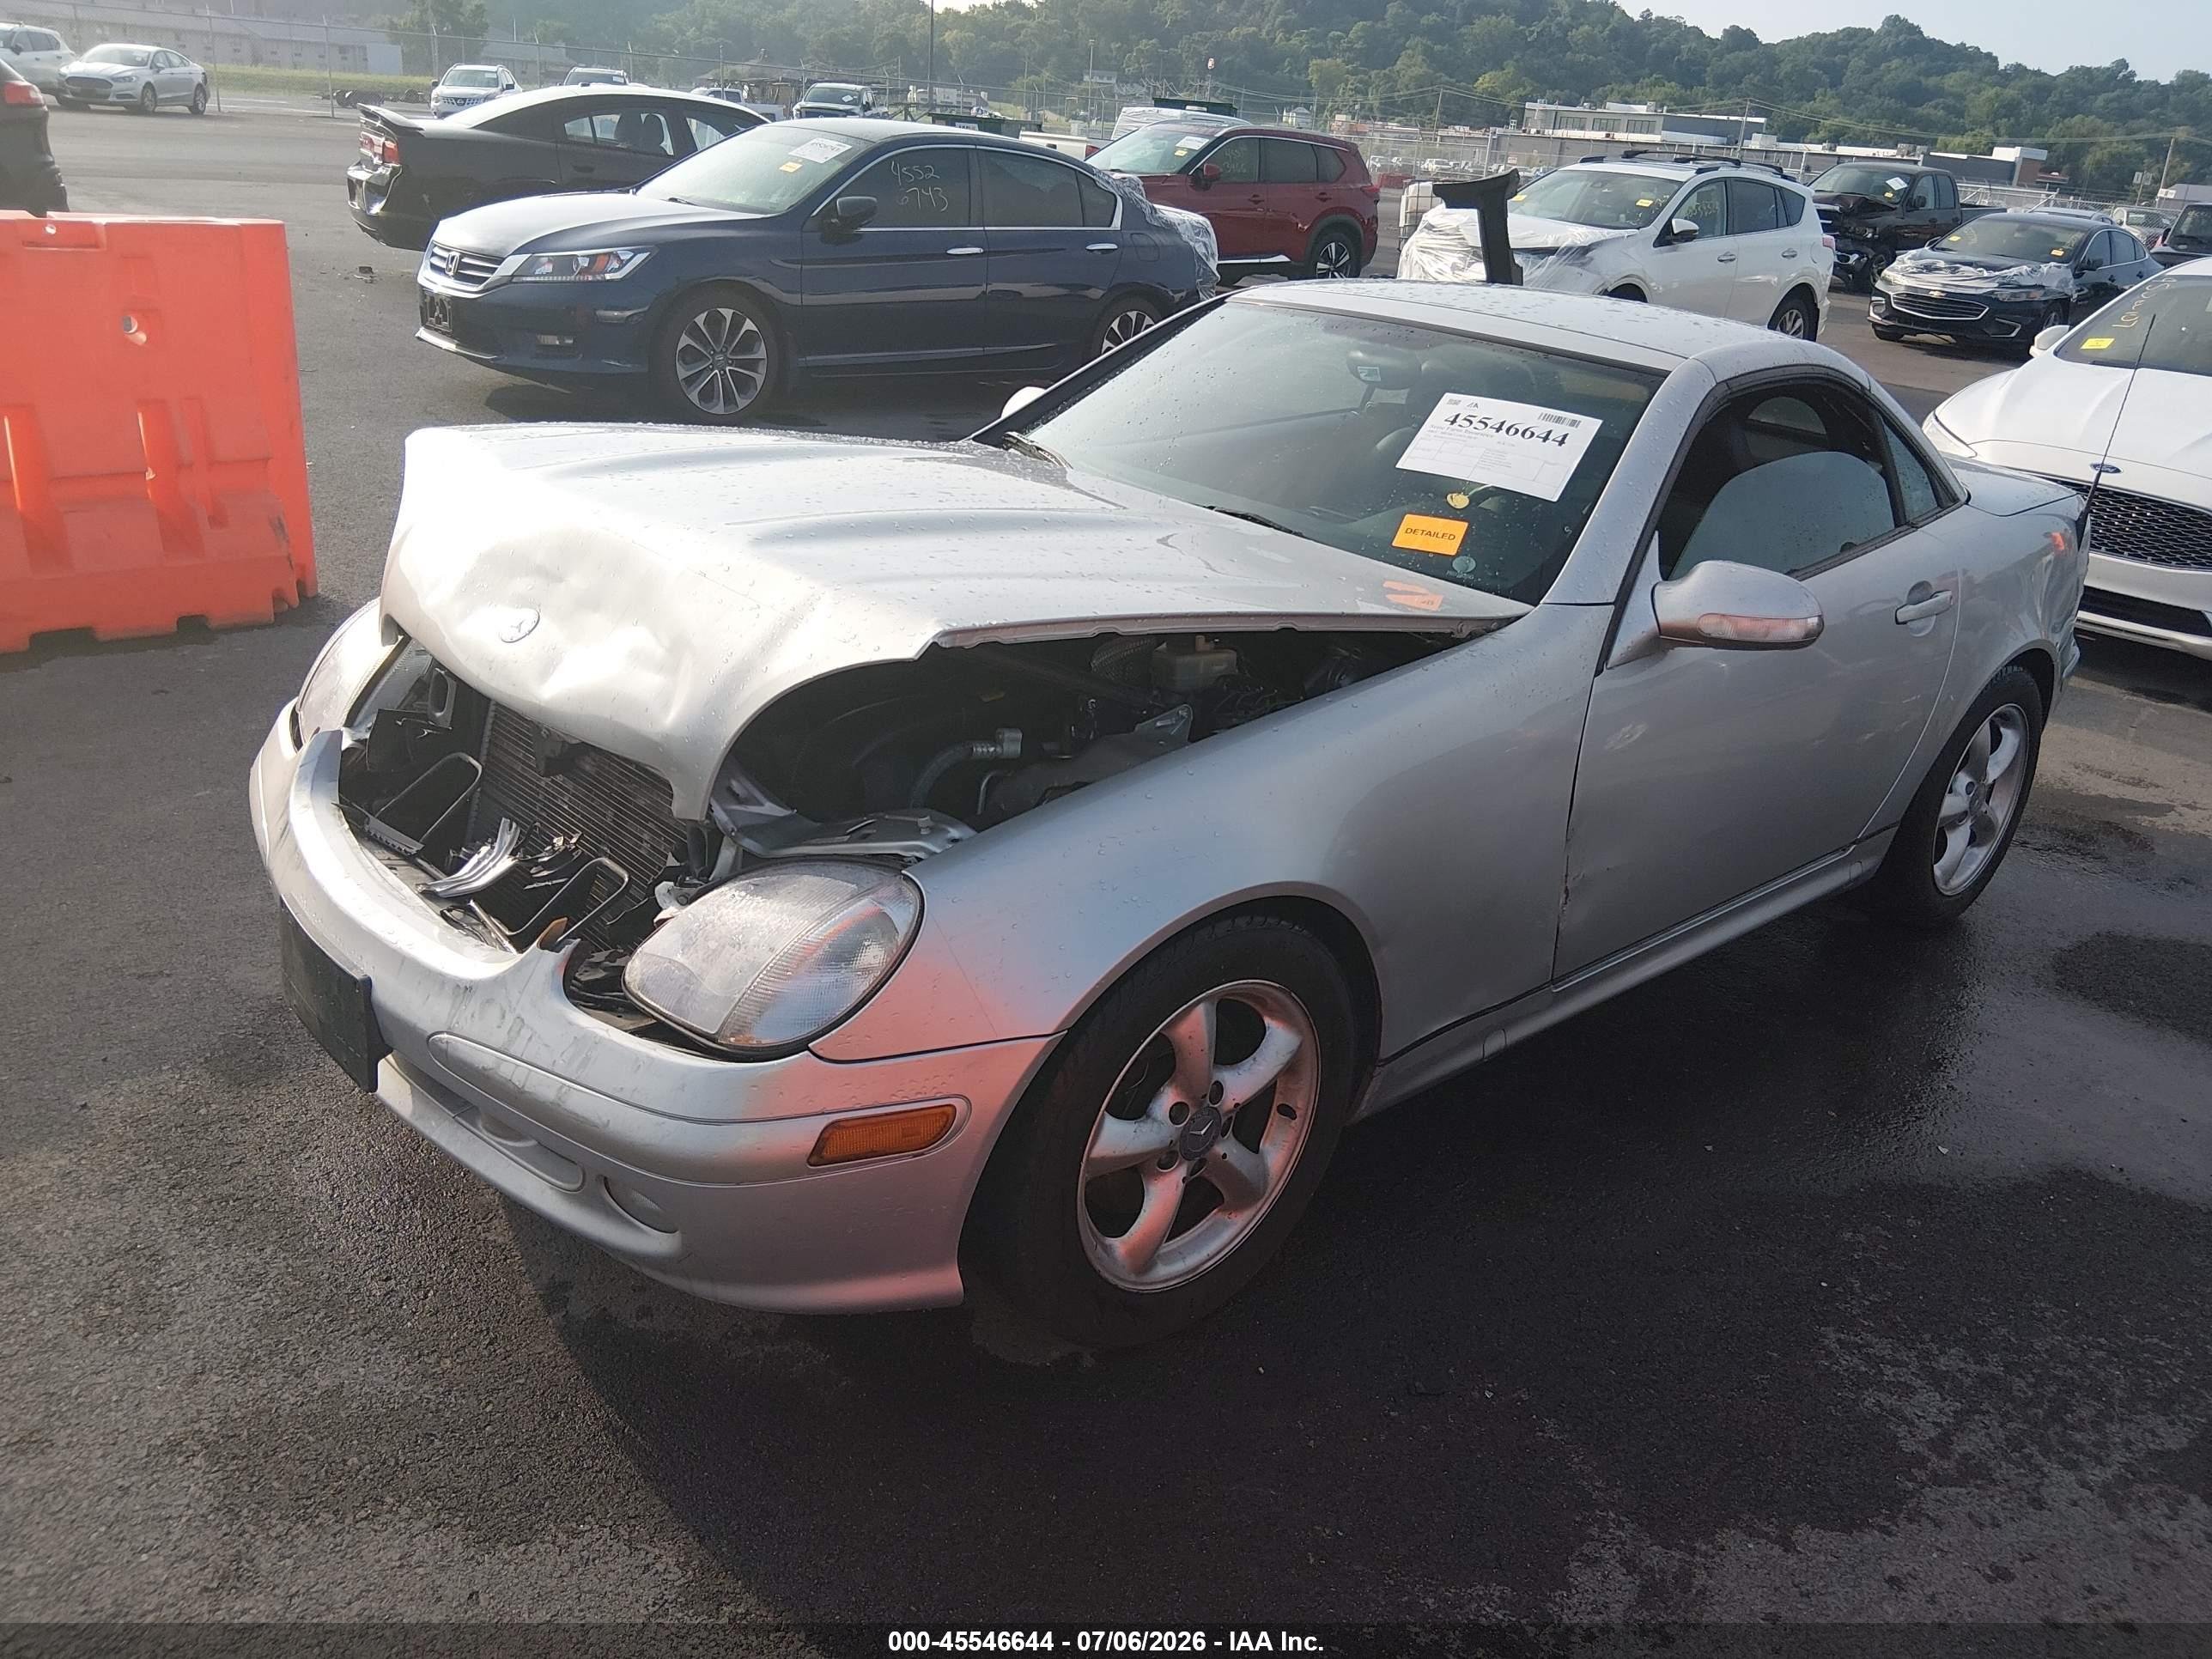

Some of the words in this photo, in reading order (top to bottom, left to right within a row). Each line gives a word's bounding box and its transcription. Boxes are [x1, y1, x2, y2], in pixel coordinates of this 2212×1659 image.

[890, 161, 940, 185] 4552
[896, 185, 949, 212] 6743
[1444, 412, 1569, 447] 45546644
[1404, 527, 1456, 541] DETAILED
